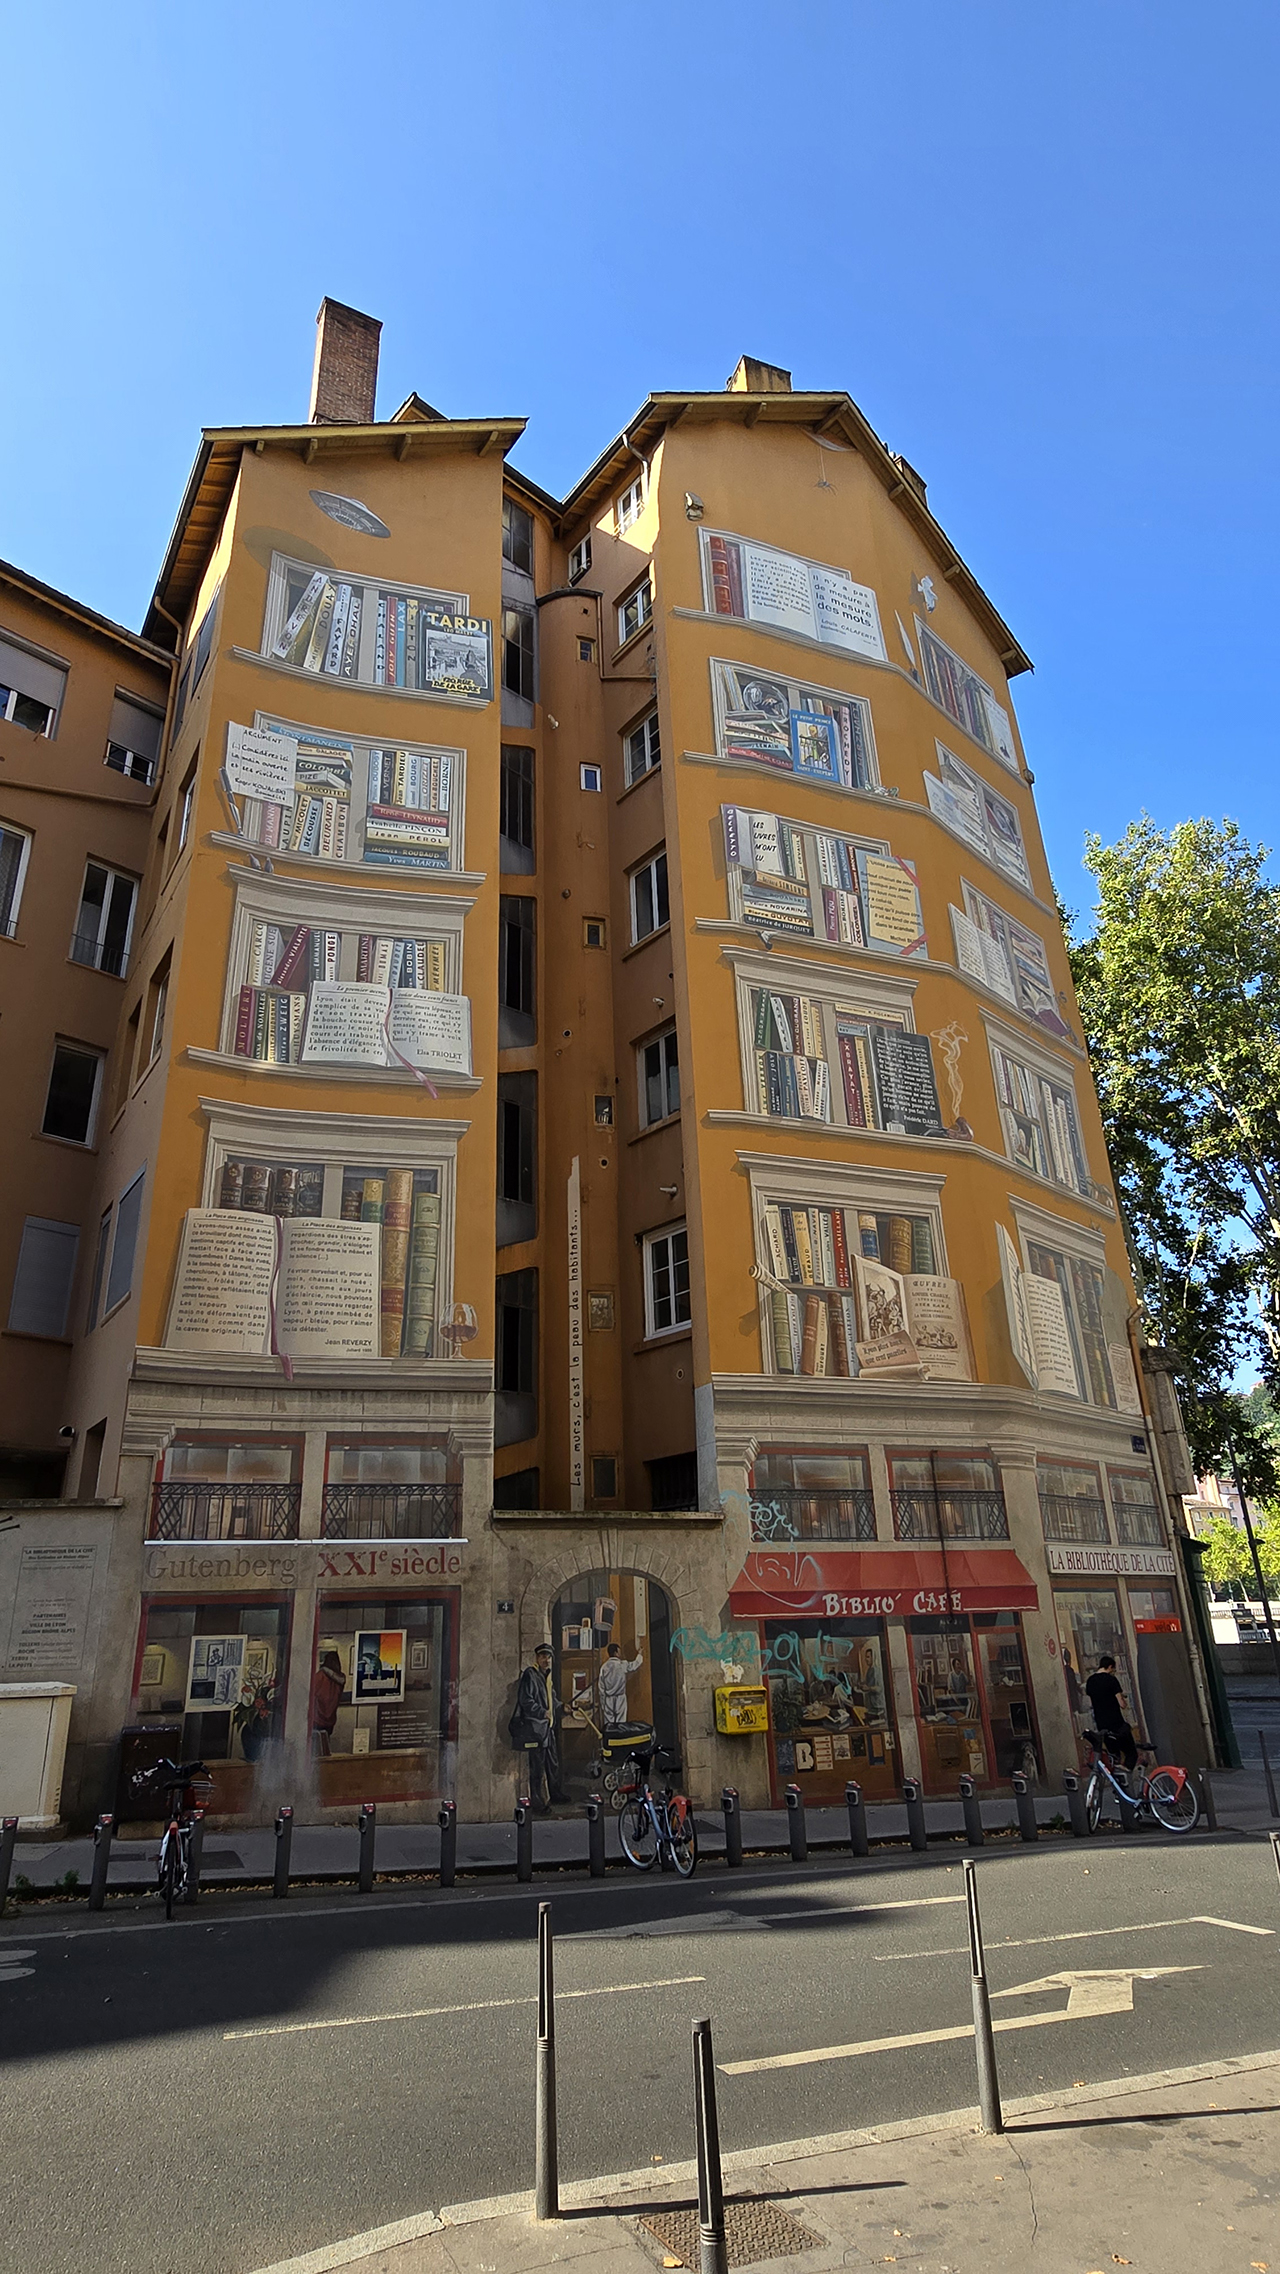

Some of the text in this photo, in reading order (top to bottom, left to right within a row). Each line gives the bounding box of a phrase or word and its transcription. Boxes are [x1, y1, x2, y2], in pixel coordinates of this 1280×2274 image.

[814, 583, 826, 591] de
[829, 589, 862, 604] mesure
[824, 578, 837, 588] n'y
[853, 589, 868, 599] pas
[319, 585, 337, 630] DOUAY
[397, 603, 406, 632] LAX
[815, 592, 872, 618] la mesure
[817, 602, 874, 629] des mots.
[427, 612, 487, 633] TARDI
[329, 618, 344, 667] FAYARD
[388, 650, 396, 678] JOLY
[243, 729, 283, 745] ARGUMENT
[298, 761, 345, 776] COLOMBI
[383, 756, 392, 789] VERNET
[397, 751, 407, 787] TARDIEU
[304, 785, 347, 797] JACCOTTET
[281, 805, 293, 851] LAUPIN
[294, 796, 311, 835] MICOLET
[322, 801, 334, 853] BEURARD
[335, 806, 347, 859] CHAMBON
[374, 831, 399, 840] Jean
[402, 849, 441, 859] ROUBAUD
[410, 858, 447, 869] MARTIN
[769, 904, 809, 915] NOVARINA
[253, 922, 265, 957] CARCO
[270, 927, 278, 947] SUE
[288, 926, 309, 958] VIALATTE
[326, 934, 336, 963] PONGE
[417, 941, 426, 982] CLAUDEL
[257, 992, 267, 1031] NOAILLES
[313, 1009, 324, 1017] de
[314, 1002, 346, 1012] complice
[316, 995, 334, 1004] Lyon
[279, 997, 289, 1033] ZWEIG
[321, 1016, 347, 1024] bouche
[307, 1044, 318, 1052] de
[430, 1050, 463, 1060] TRIOLET
[843, 1037, 856, 1095] EXBRAYAT
[834, 1208, 843, 1247] VAILLAND
[771, 1228, 781, 1259] ACHARD
[341, 1338, 373, 1346] REVERZY
[568, 1208, 584, 1487] Les murs, c'est la peau des habitants...
[145, 1549, 298, 1586] Gutenberg
[390, 1546, 461, 1577] siècle
[1049, 1550, 1065, 1570] LA
[1065, 1548, 1129, 1574] BIBLIOTHÈQUE
[1130, 1552, 1142, 1572] DE
[1142, 1553, 1156, 1573] LA
[913, 1589, 962, 1614] CAFÉ
